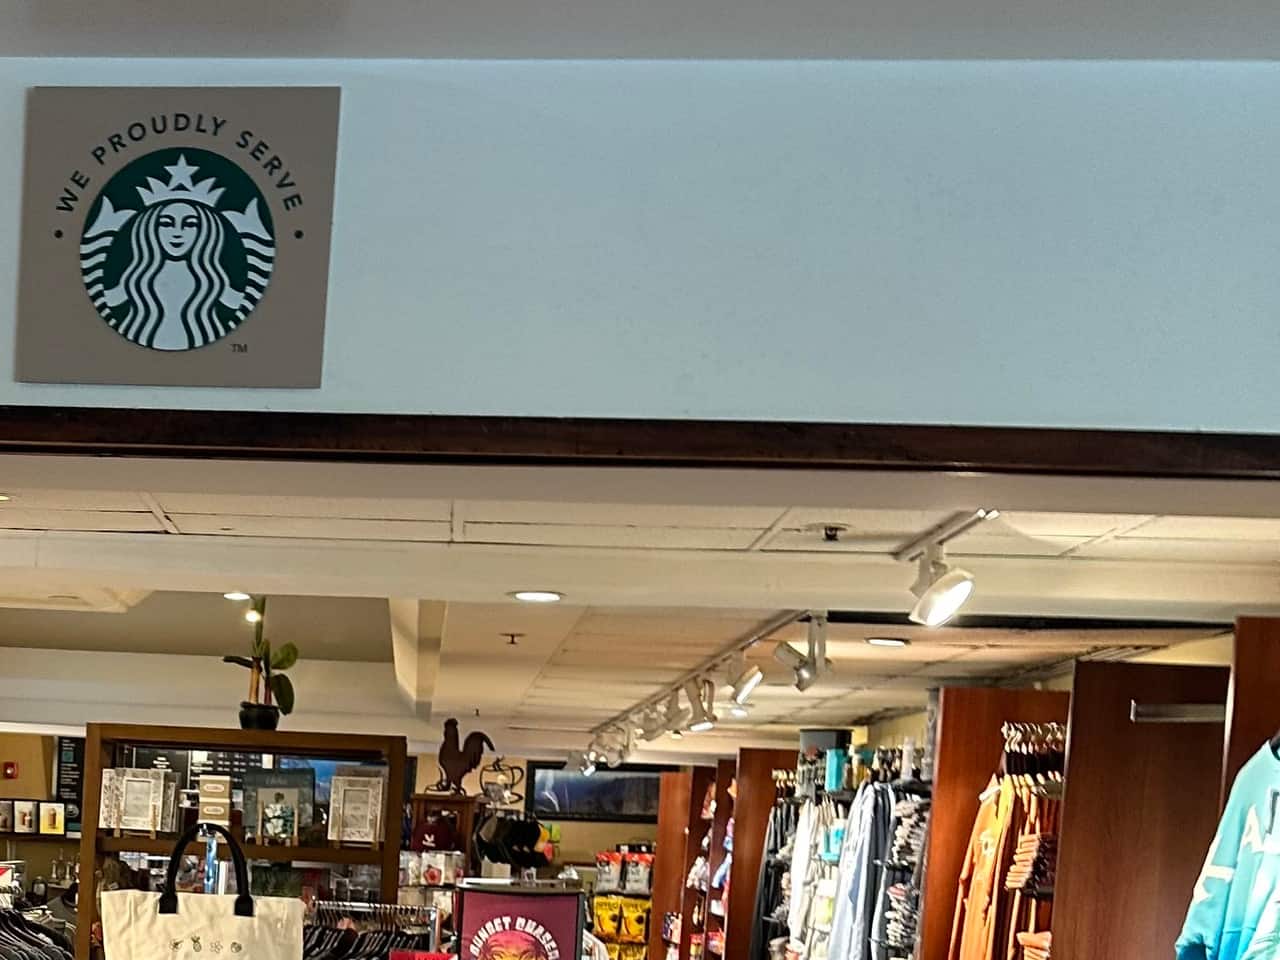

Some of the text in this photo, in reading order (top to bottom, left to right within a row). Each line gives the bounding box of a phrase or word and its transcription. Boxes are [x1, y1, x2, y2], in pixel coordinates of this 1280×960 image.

[55, 112, 303, 214] WE PROUDLY SERVE
